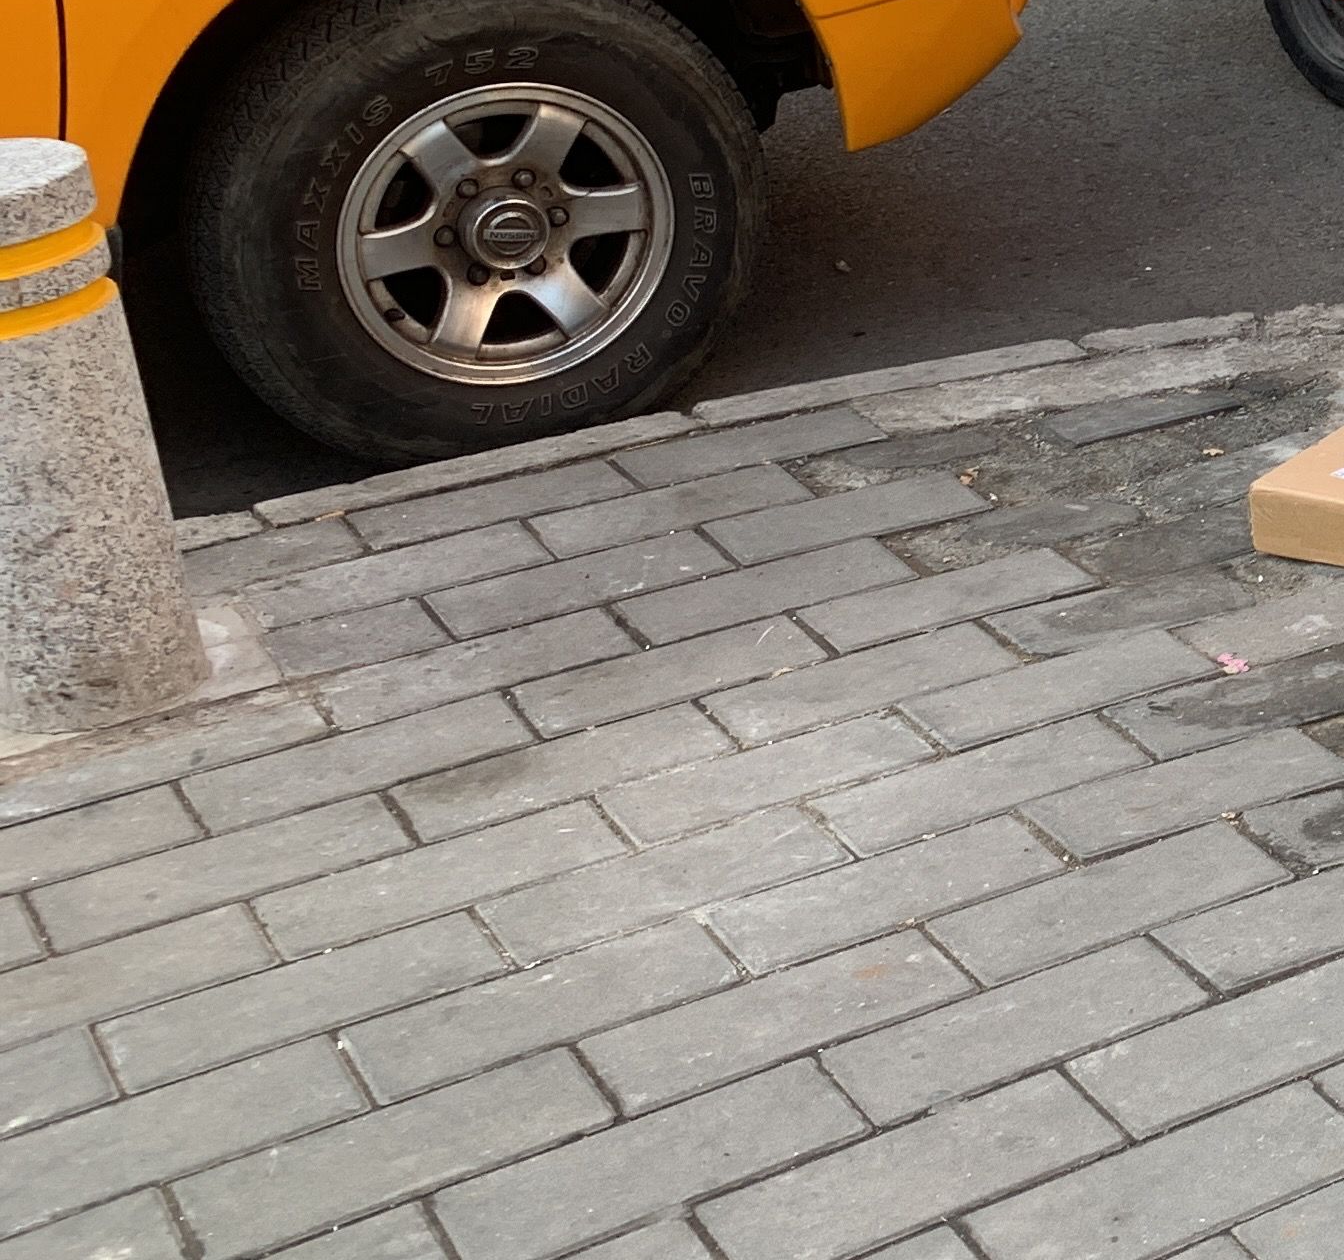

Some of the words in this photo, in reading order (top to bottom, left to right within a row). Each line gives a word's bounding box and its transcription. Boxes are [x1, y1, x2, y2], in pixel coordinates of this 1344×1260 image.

[424, 46, 539, 87] 752
[293, 94, 393, 293] MAXXIS
[665, 172, 718, 328] BRAVO
[470, 342, 654, 425] RADIAL
